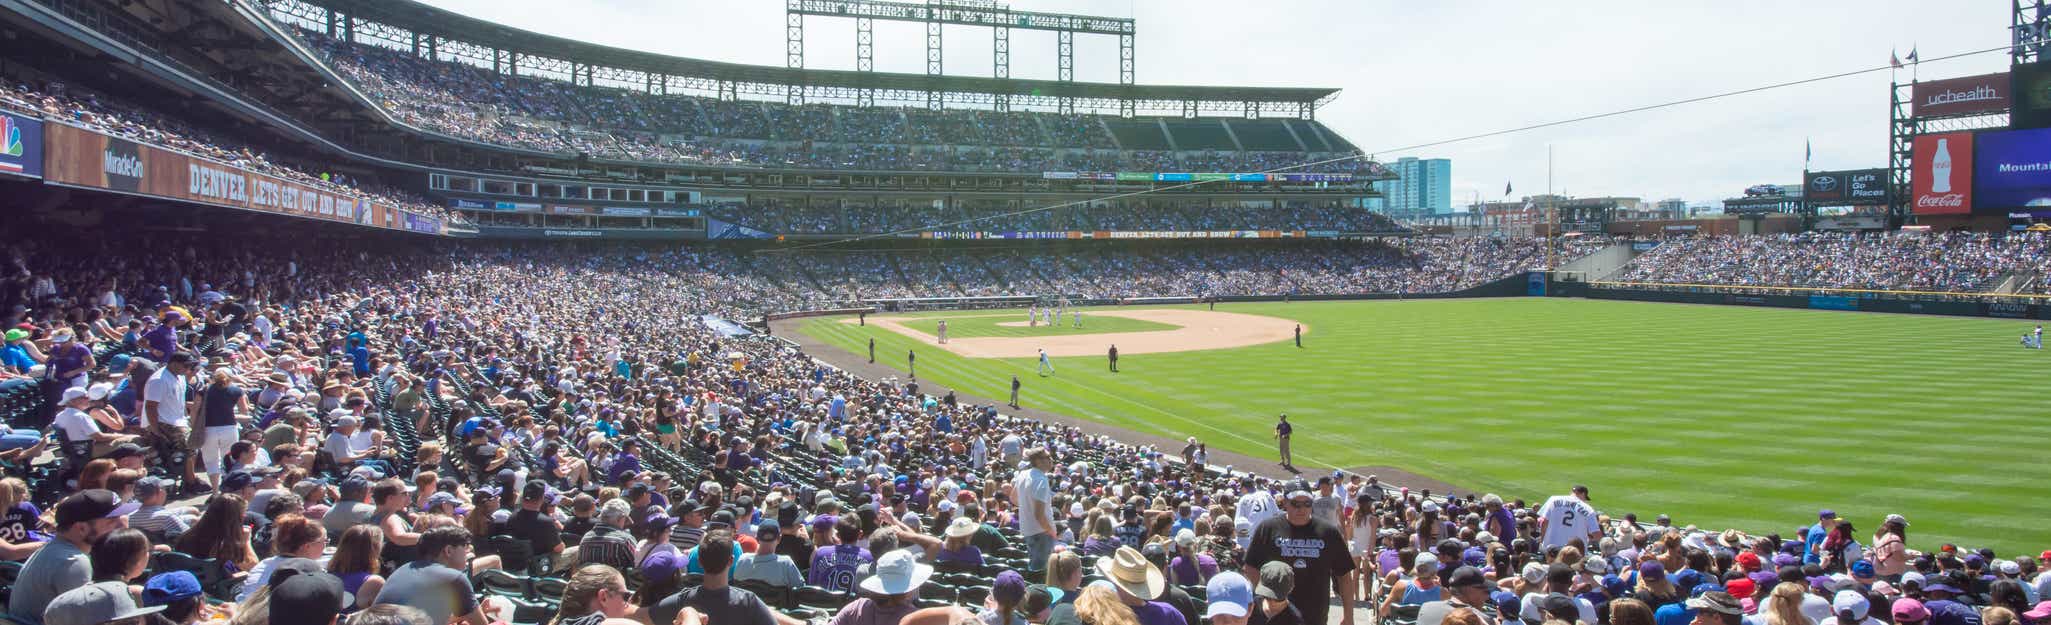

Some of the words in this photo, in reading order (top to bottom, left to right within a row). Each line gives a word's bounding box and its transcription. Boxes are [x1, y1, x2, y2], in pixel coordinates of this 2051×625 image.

[1928, 85, 1996, 105] uchealth
[1852, 174, 1876, 182] Let's
[1852, 182, 1866, 190] Go
[190, 164, 249, 207] DENVER,
[253, 178, 278, 208] LETS
[282, 186, 299, 209] GET
[302, 191, 317, 212] OUT
[319, 195, 334, 215] AND
[1562, 510, 1575, 527] 2
[0, 522, 26, 542] 28
[1275, 537, 1325, 549] COLORADO
[828, 569, 855, 592] 19
